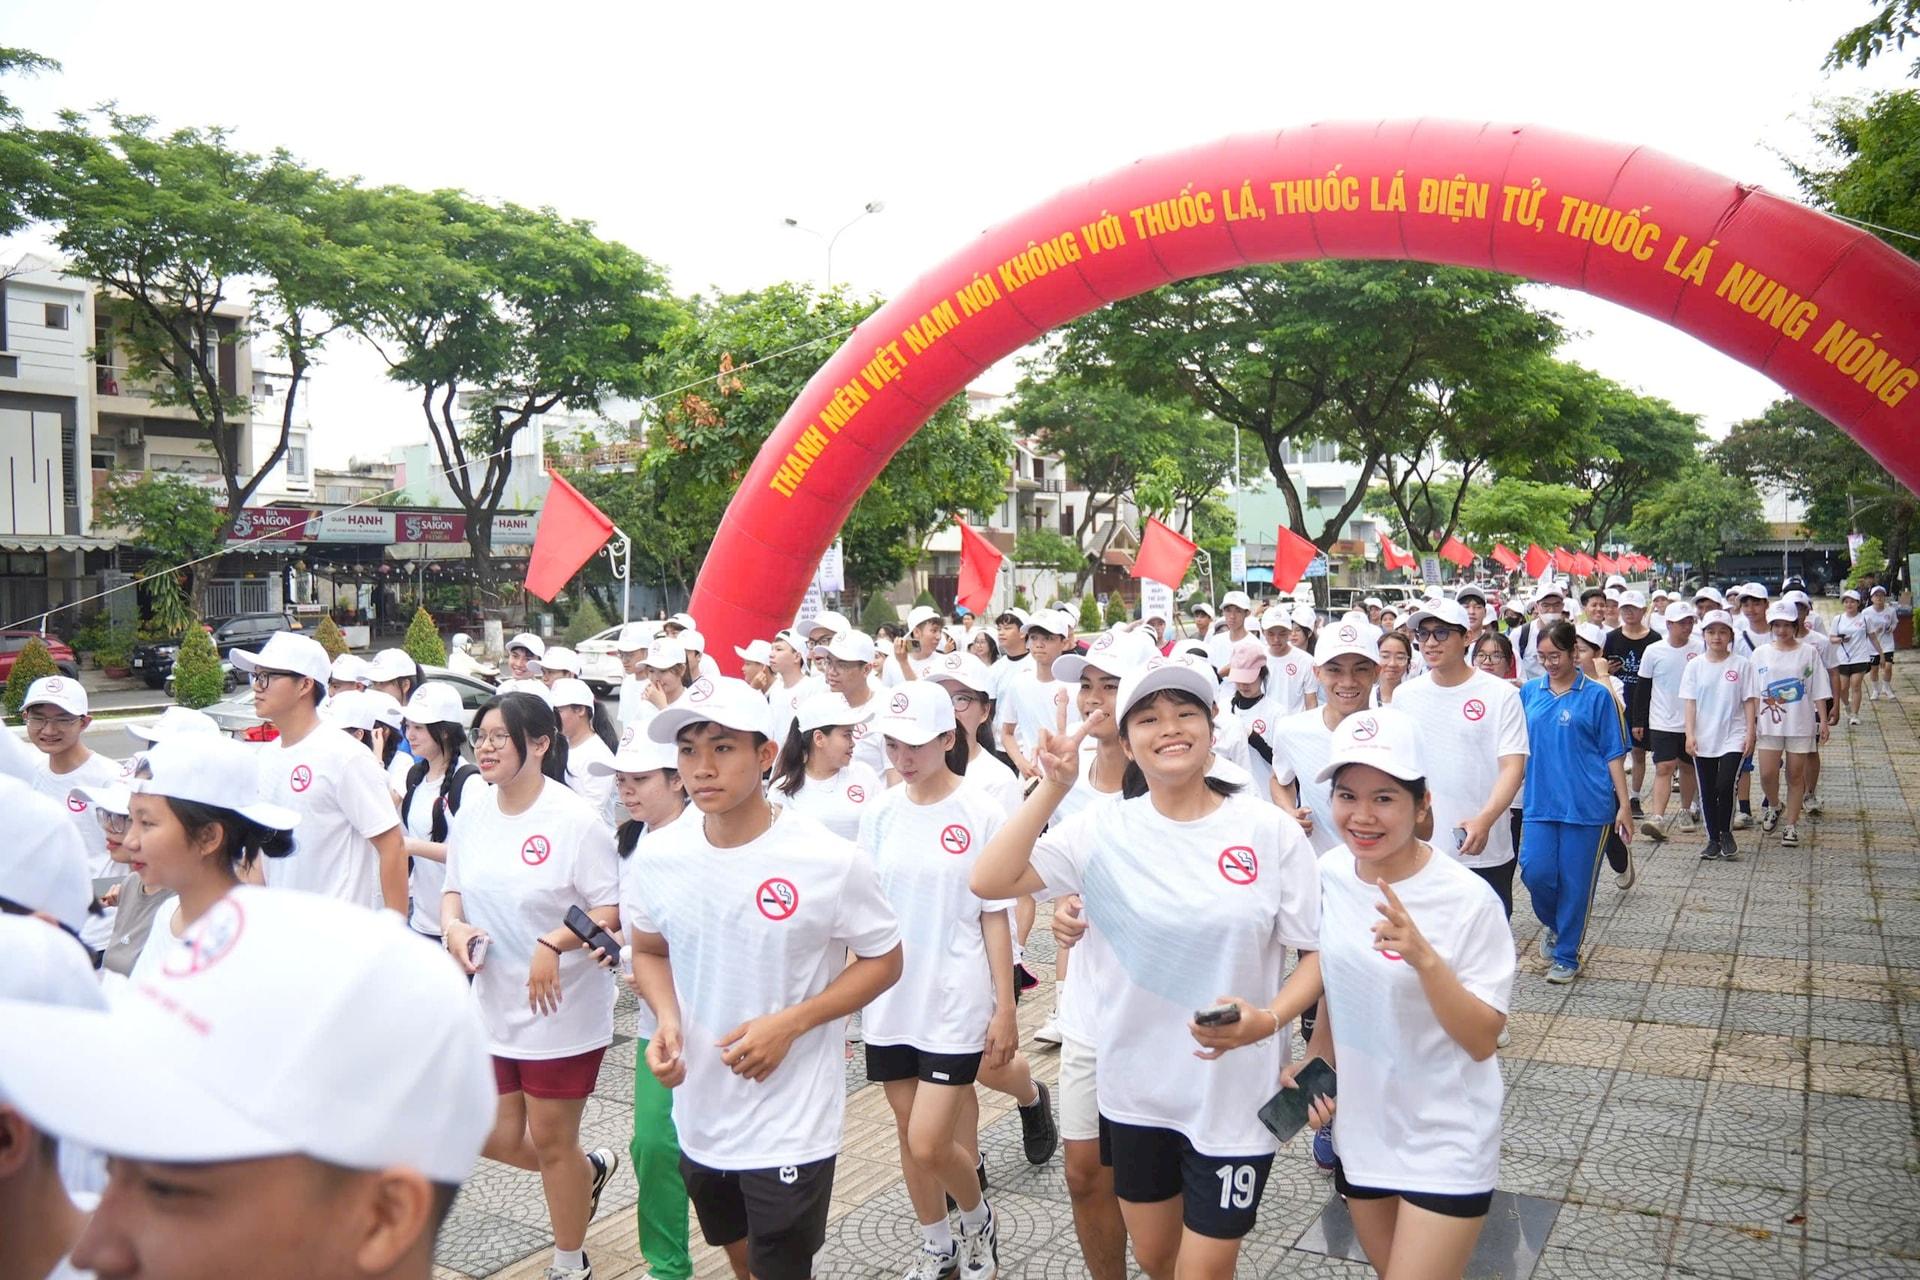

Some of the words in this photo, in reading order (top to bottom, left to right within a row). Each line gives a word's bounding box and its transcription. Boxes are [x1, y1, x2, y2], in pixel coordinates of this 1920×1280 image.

[769, 424, 830, 498] THANH
[818, 377, 871, 433] NIÊN
[860, 339, 909, 391] VIỆT
[902, 298, 961, 354] NAM
[955, 271, 1001, 317] NÓI
[997, 231, 1082, 293] KHÔNG
[1080, 211, 1127, 254] VỚI
[1129, 182, 1216, 239] THUỐC
[1221, 179, 1266, 221] LÁ,
[1270, 164, 1361, 214] THUỐC
[1370, 169, 1407, 212] LÁ
[1418, 173, 1490, 223] ĐIỆN
[1503, 177, 1548, 232] TỬ,
[1557, 195, 1662, 261] THUỐC
[1663, 237, 1719, 287] LÁ
[1716, 261, 1820, 341] NUNG
[1813, 318, 1919, 407] NÓNG
[252, 515, 291, 526] SAIGON
[347, 515, 383, 528] HẠNH
[421, 520, 453, 530] SAIGON
[498, 519, 528, 531] HẠNH
[1215, 1164, 1257, 1209] 19
